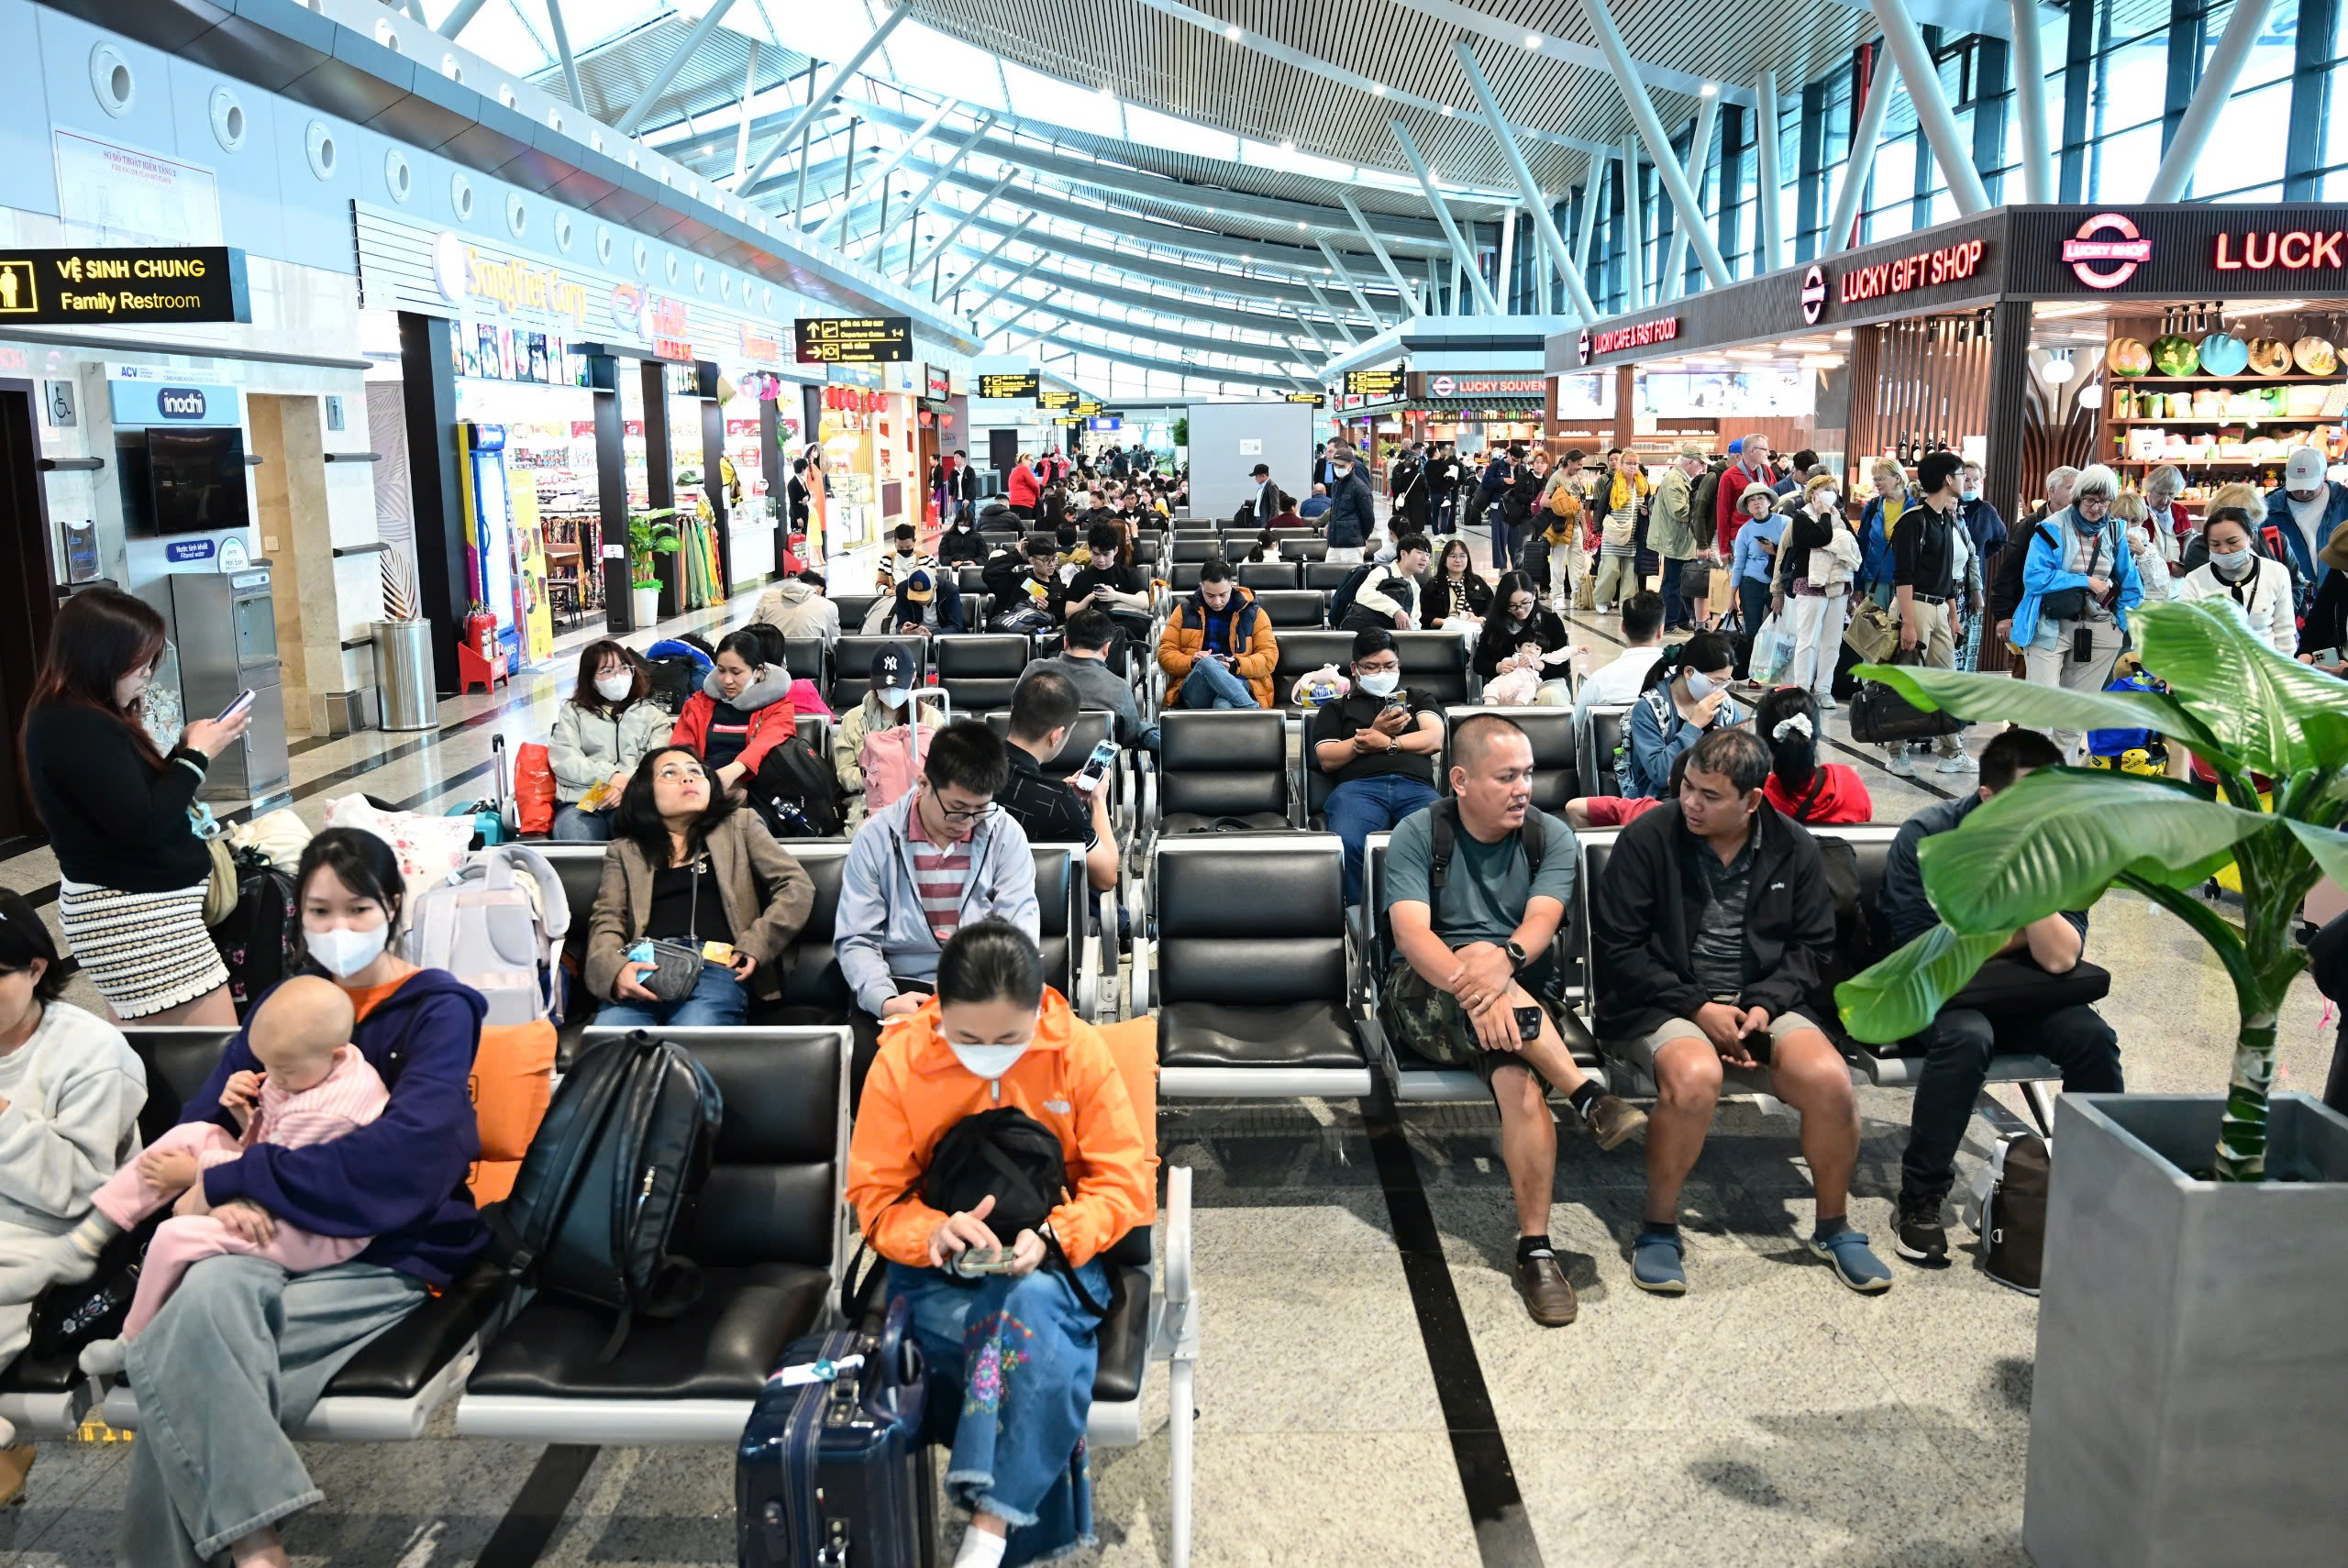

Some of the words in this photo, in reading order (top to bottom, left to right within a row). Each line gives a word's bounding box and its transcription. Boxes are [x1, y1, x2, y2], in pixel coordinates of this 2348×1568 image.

[2066, 244, 2110, 258] LUCKY
[2111, 244, 2148, 257] SHOP
[2216, 231, 2348, 270] LUCK
[57, 257, 83, 282] VỆ
[86, 260, 130, 279] SINH
[134, 259, 205, 278] CHUNG
[1841, 262, 1889, 304] LUCKY
[1891, 253, 1930, 293] GIFT
[1931, 239, 1982, 284] SHOP
[61, 293, 116, 314] Family
[120, 292, 201, 309] Restroom
[1594, 331, 1614, 354] LUCKY
[1614, 327, 1630, 350] CAFE
[1630, 326, 1636, 346] &
[1636, 322, 1654, 345] FAST
[1655, 317, 1676, 341] FOOD
[121, 366, 138, 378] ACV
[1459, 381, 1499, 392] LUCKY
